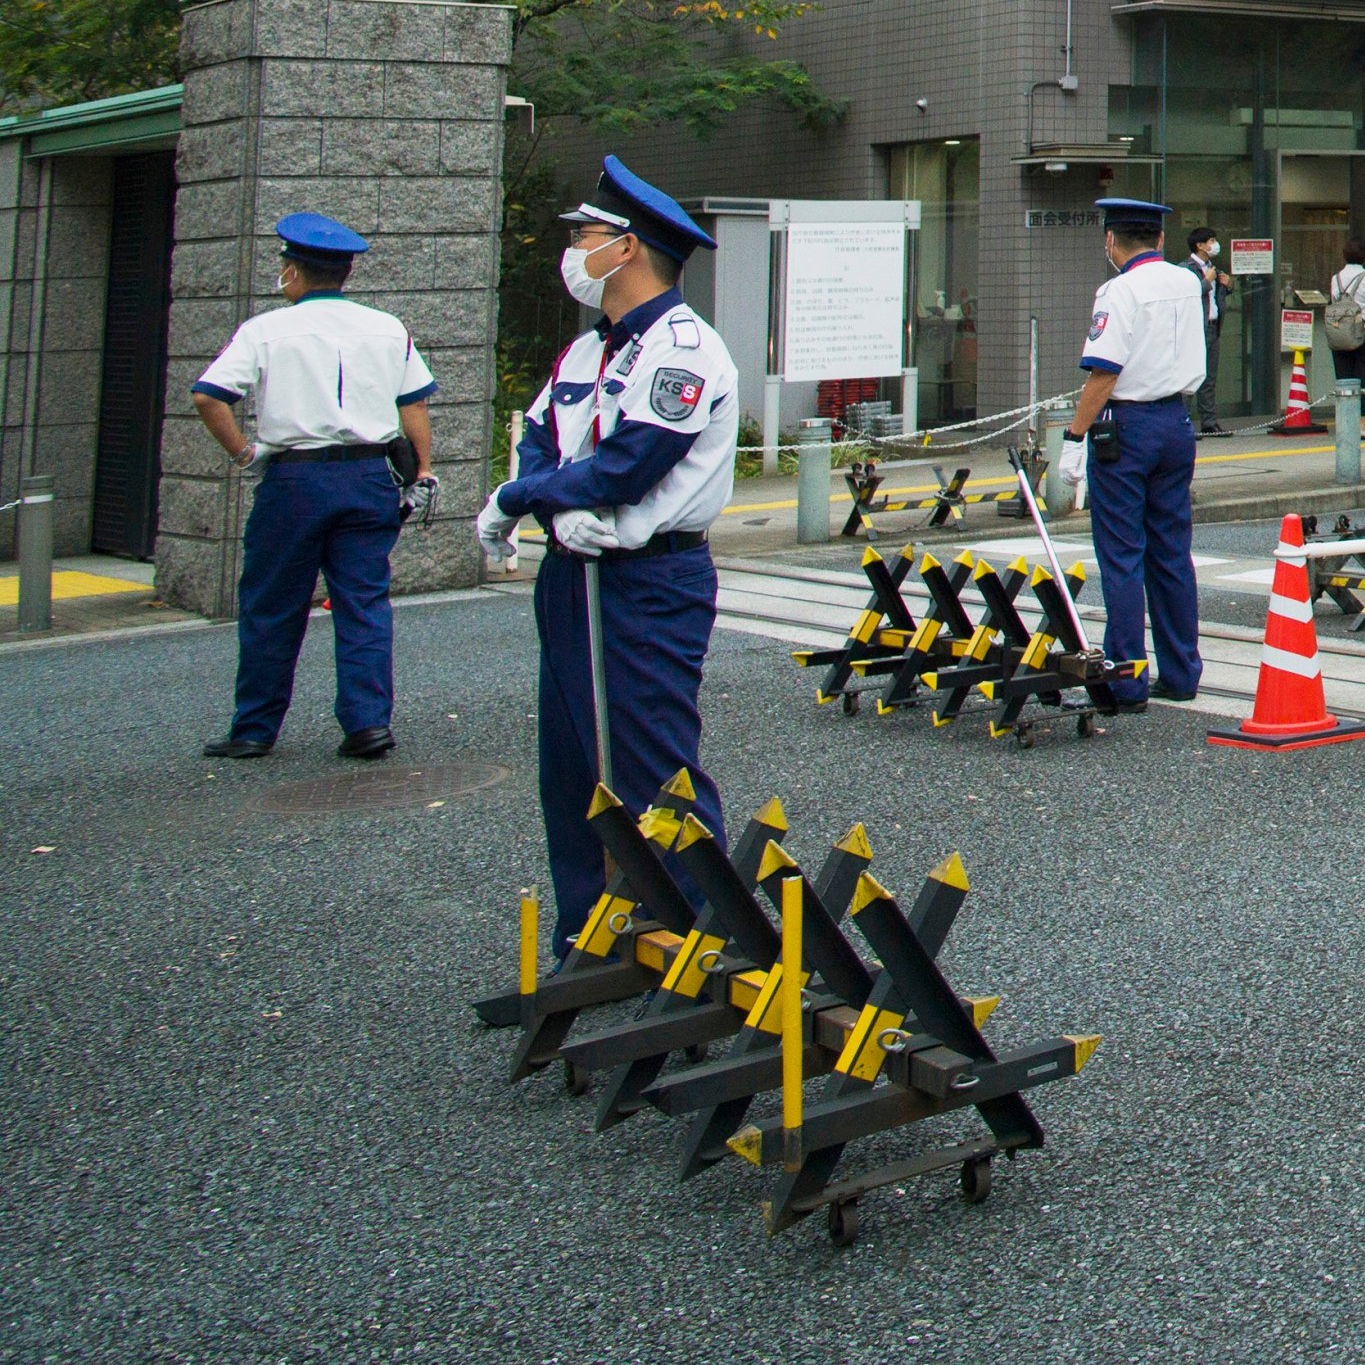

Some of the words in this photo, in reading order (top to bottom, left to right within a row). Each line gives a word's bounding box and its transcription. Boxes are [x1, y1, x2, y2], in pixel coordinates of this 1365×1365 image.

[1028, 211, 1100, 226] 面会受付所
[664, 371, 699, 383] SECURITY
[658, 378, 696, 400] KSS
